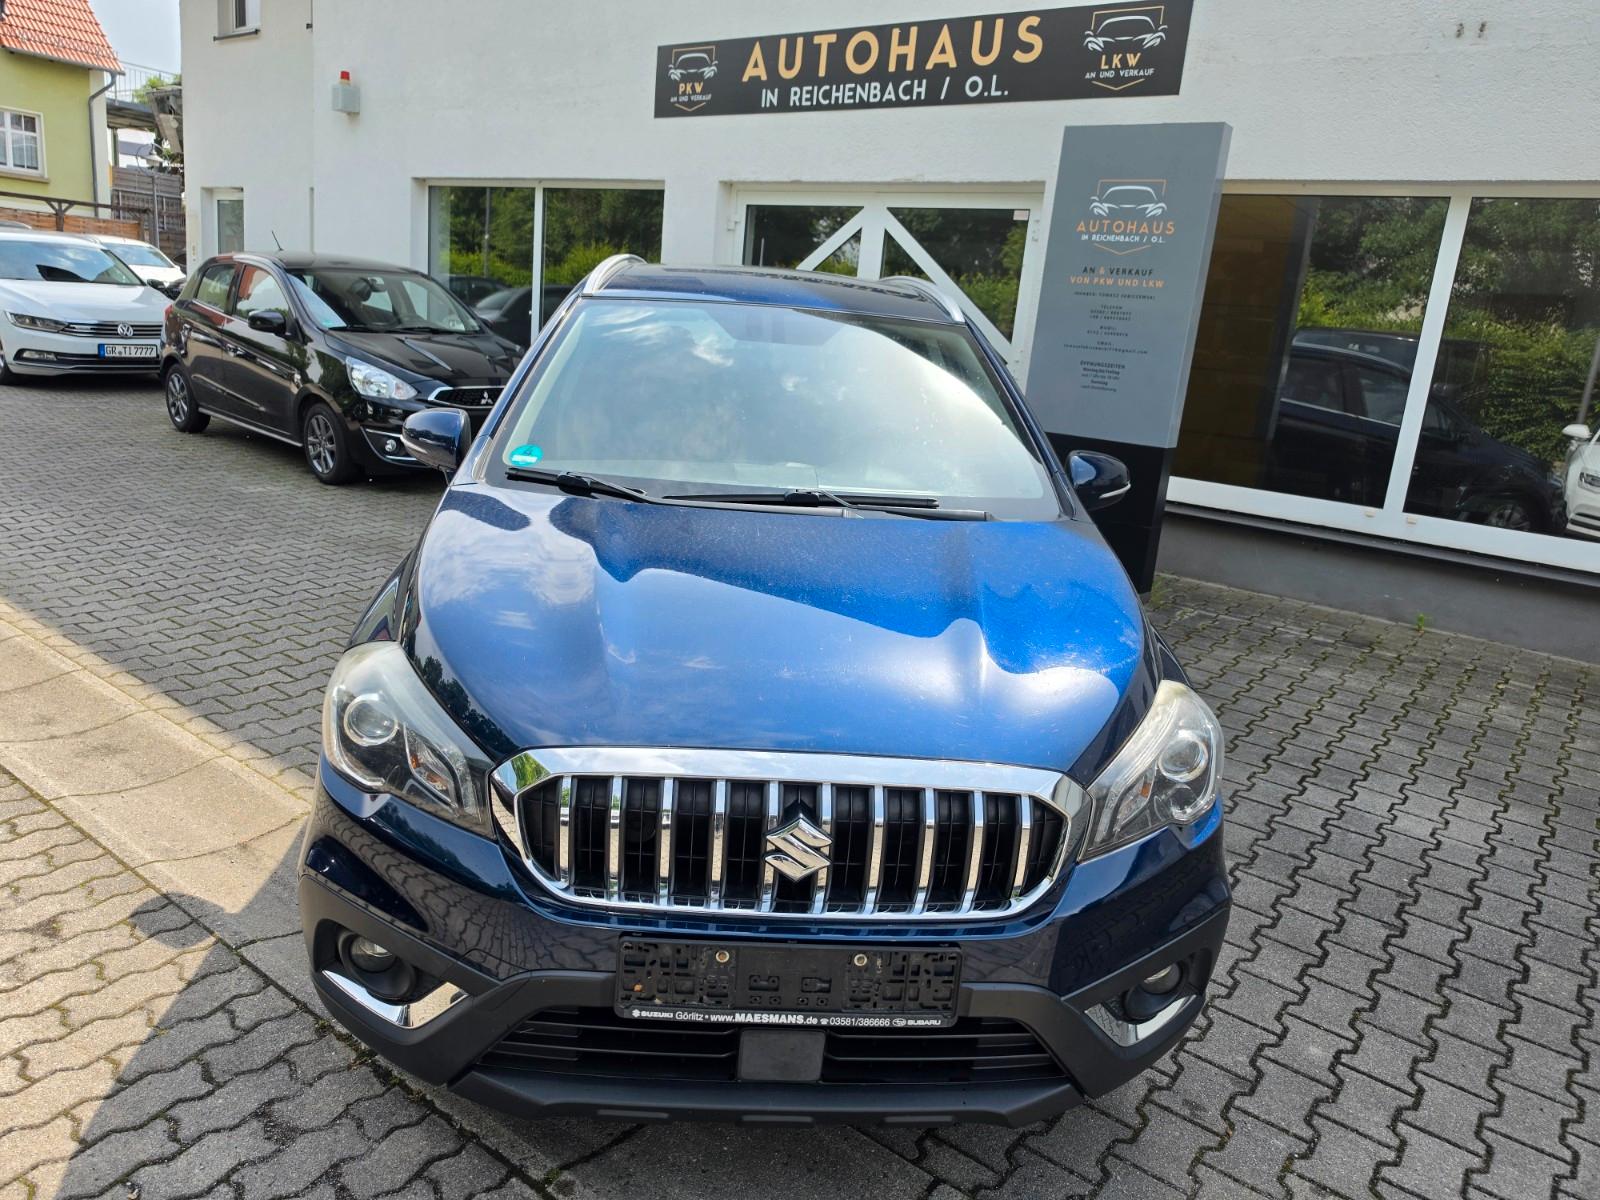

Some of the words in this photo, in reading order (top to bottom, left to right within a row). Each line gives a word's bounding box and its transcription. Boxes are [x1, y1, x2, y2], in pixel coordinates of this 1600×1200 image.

[741, 15, 1043, 82] AUTOHAUS
[1101, 52, 1142, 69] LKW
[1085, 71, 1096, 79] AN
[1099, 70, 1115, 78] UND
[1119, 68, 1156, 77] VERKAUF
[679, 82, 704, 95] PKW
[761, 88, 779, 108] IN
[790, 79, 927, 107] REICHENBACH
[940, 76, 950, 100] /
[965, 74, 1009, 98] O.L.
[1076, 219, 1175, 235] AUTOHAUS
[1091, 233, 1140, 242] REICHENBACH
[1082, 265, 1096, 275] AN
[1109, 267, 1154, 277] VERKAUF
[1070, 275, 1090, 284] VON
[1118, 278, 1139, 287] UND
[1143, 279, 1165, 288] LKW
[106, 346, 117, 355] GR
[675, 1011, 704, 1021] Görlitz
[710, 1013, 818, 1025] www.MAESMANS.de
[829, 1016, 891, 1026] 03581/386666
